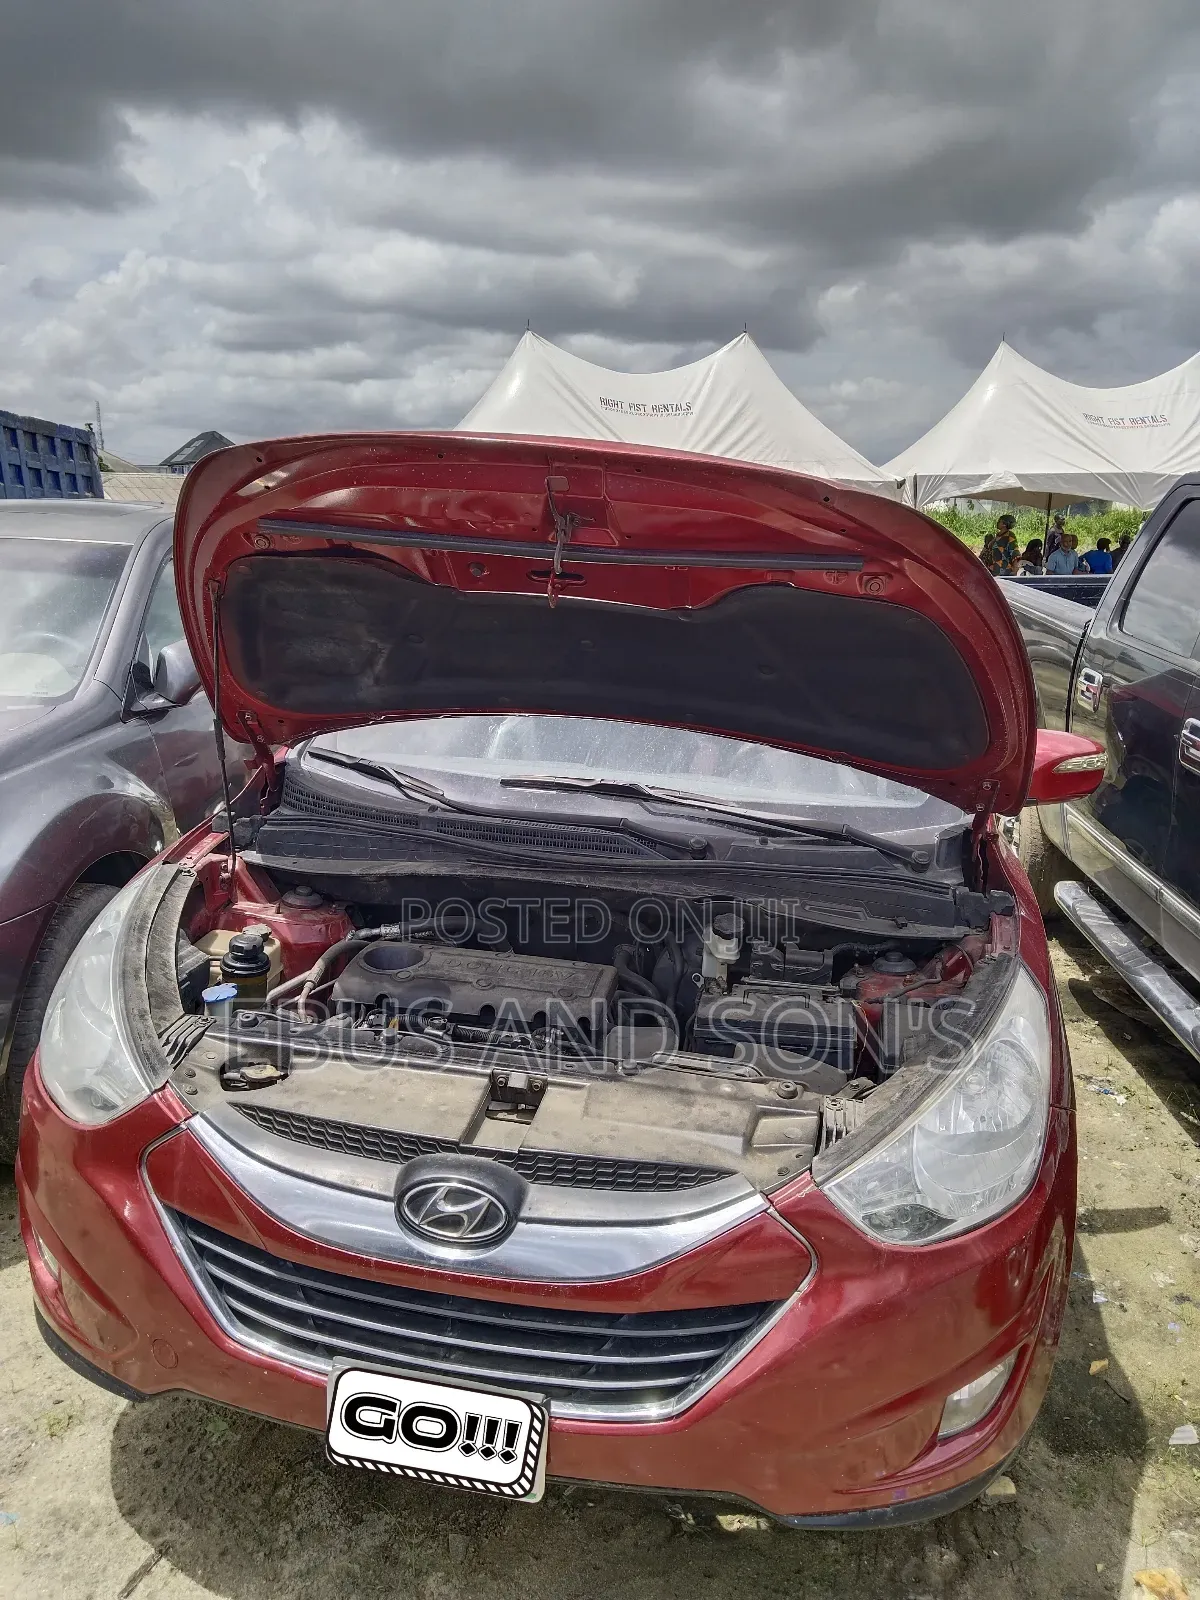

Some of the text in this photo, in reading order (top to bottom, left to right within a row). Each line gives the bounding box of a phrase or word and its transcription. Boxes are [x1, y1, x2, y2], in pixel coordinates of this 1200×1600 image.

[599, 396, 625, 410] RIGHT
[628, 402, 648, 413] FIST
[651, 401, 692, 413] RENTALS
[1082, 412, 1106, 424] RIGHT
[1108, 417, 1125, 426] FIST
[1128, 414, 1168, 426] RENTALS
